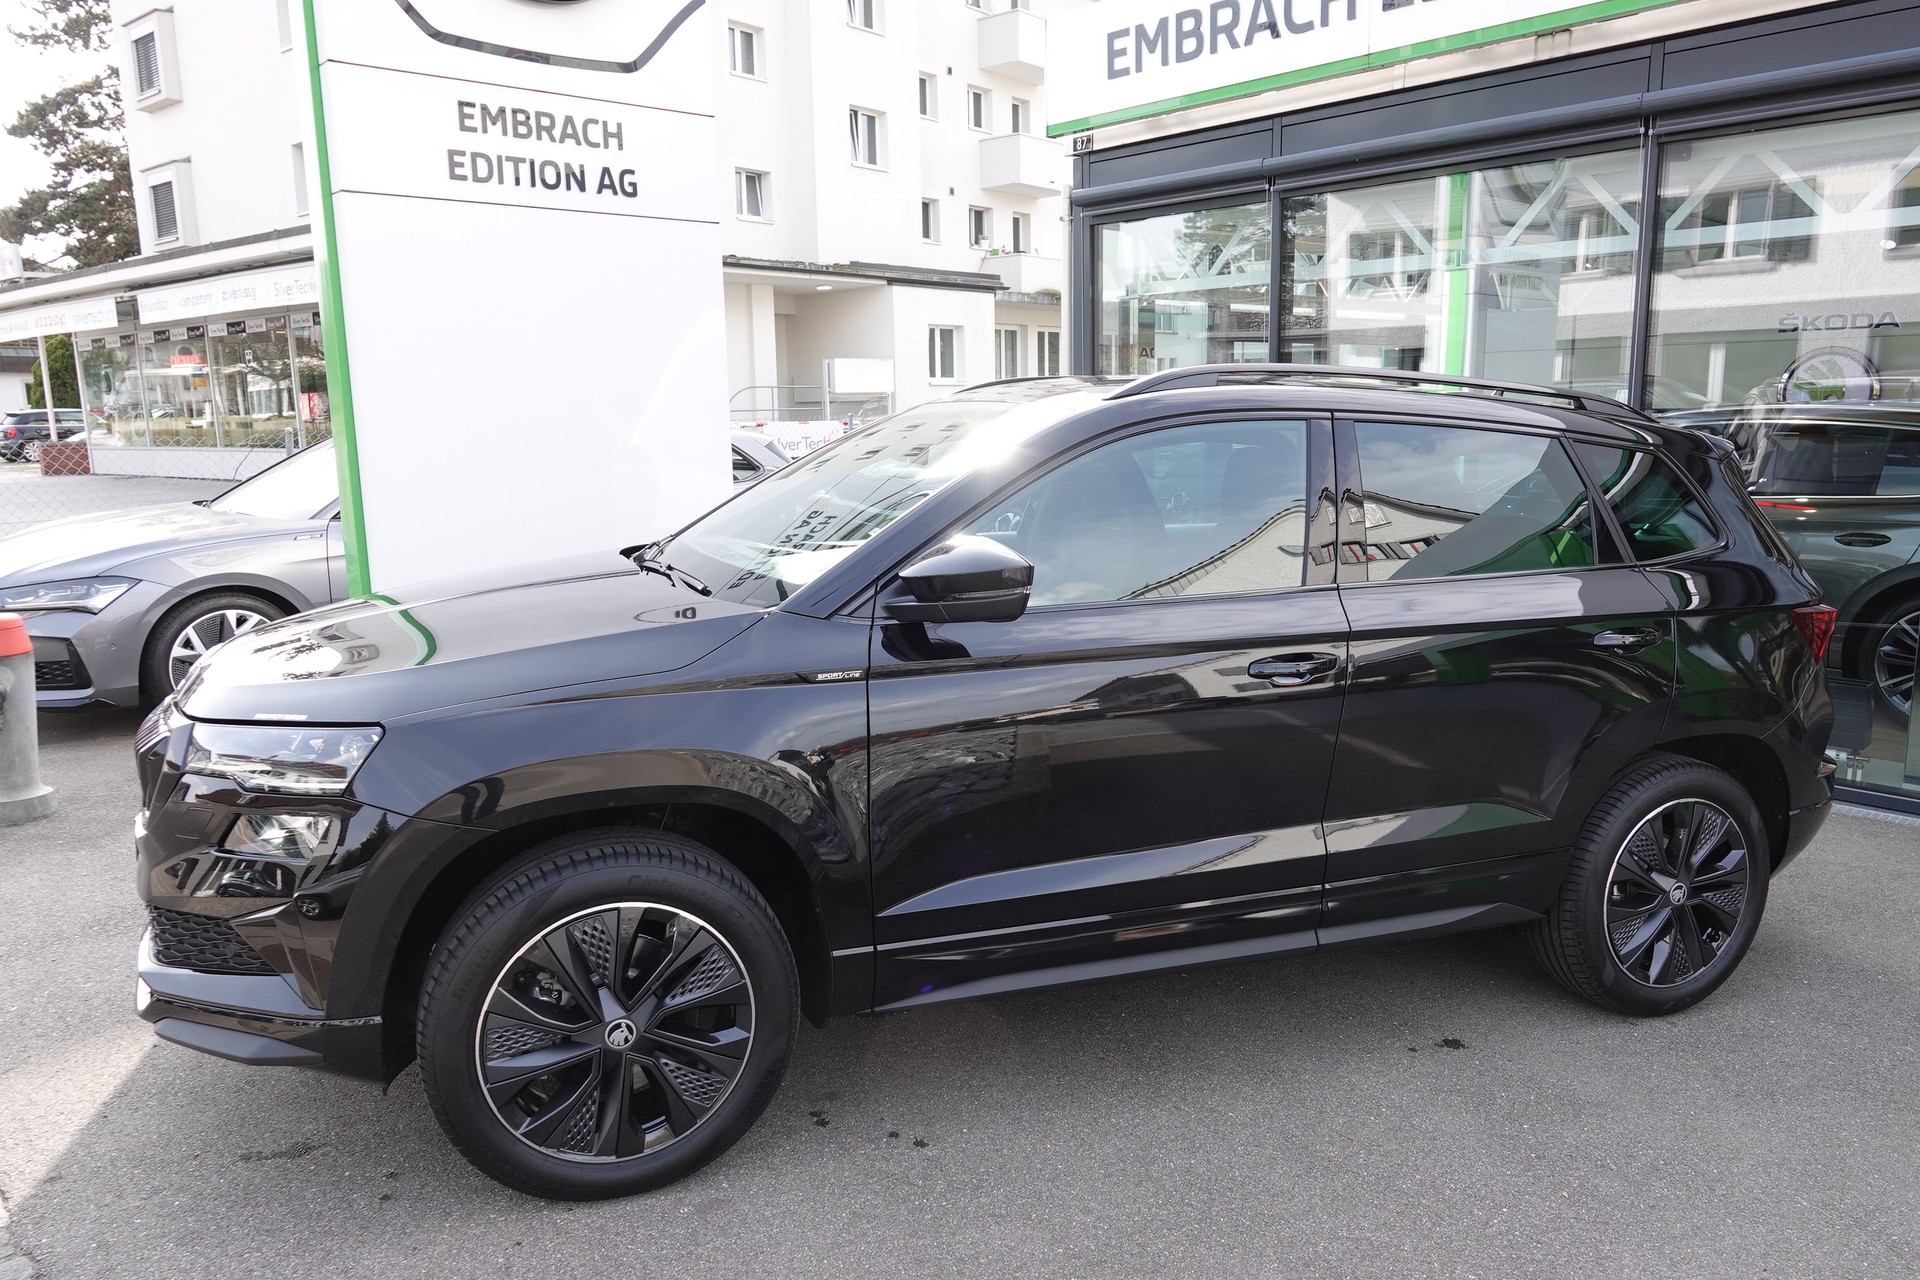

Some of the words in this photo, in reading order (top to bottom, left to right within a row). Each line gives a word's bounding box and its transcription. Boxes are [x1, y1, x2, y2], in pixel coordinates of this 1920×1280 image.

[457, 100, 623, 151] EMBRACH
[1076, 136, 1088, 150] 87
[447, 149, 587, 193] EDITION
[596, 166, 638, 198] AG
[273, 279, 313, 298] SilverTech
[1778, 311, 1901, 333] ŠKODA
[778, 436, 831, 451] lverTech
